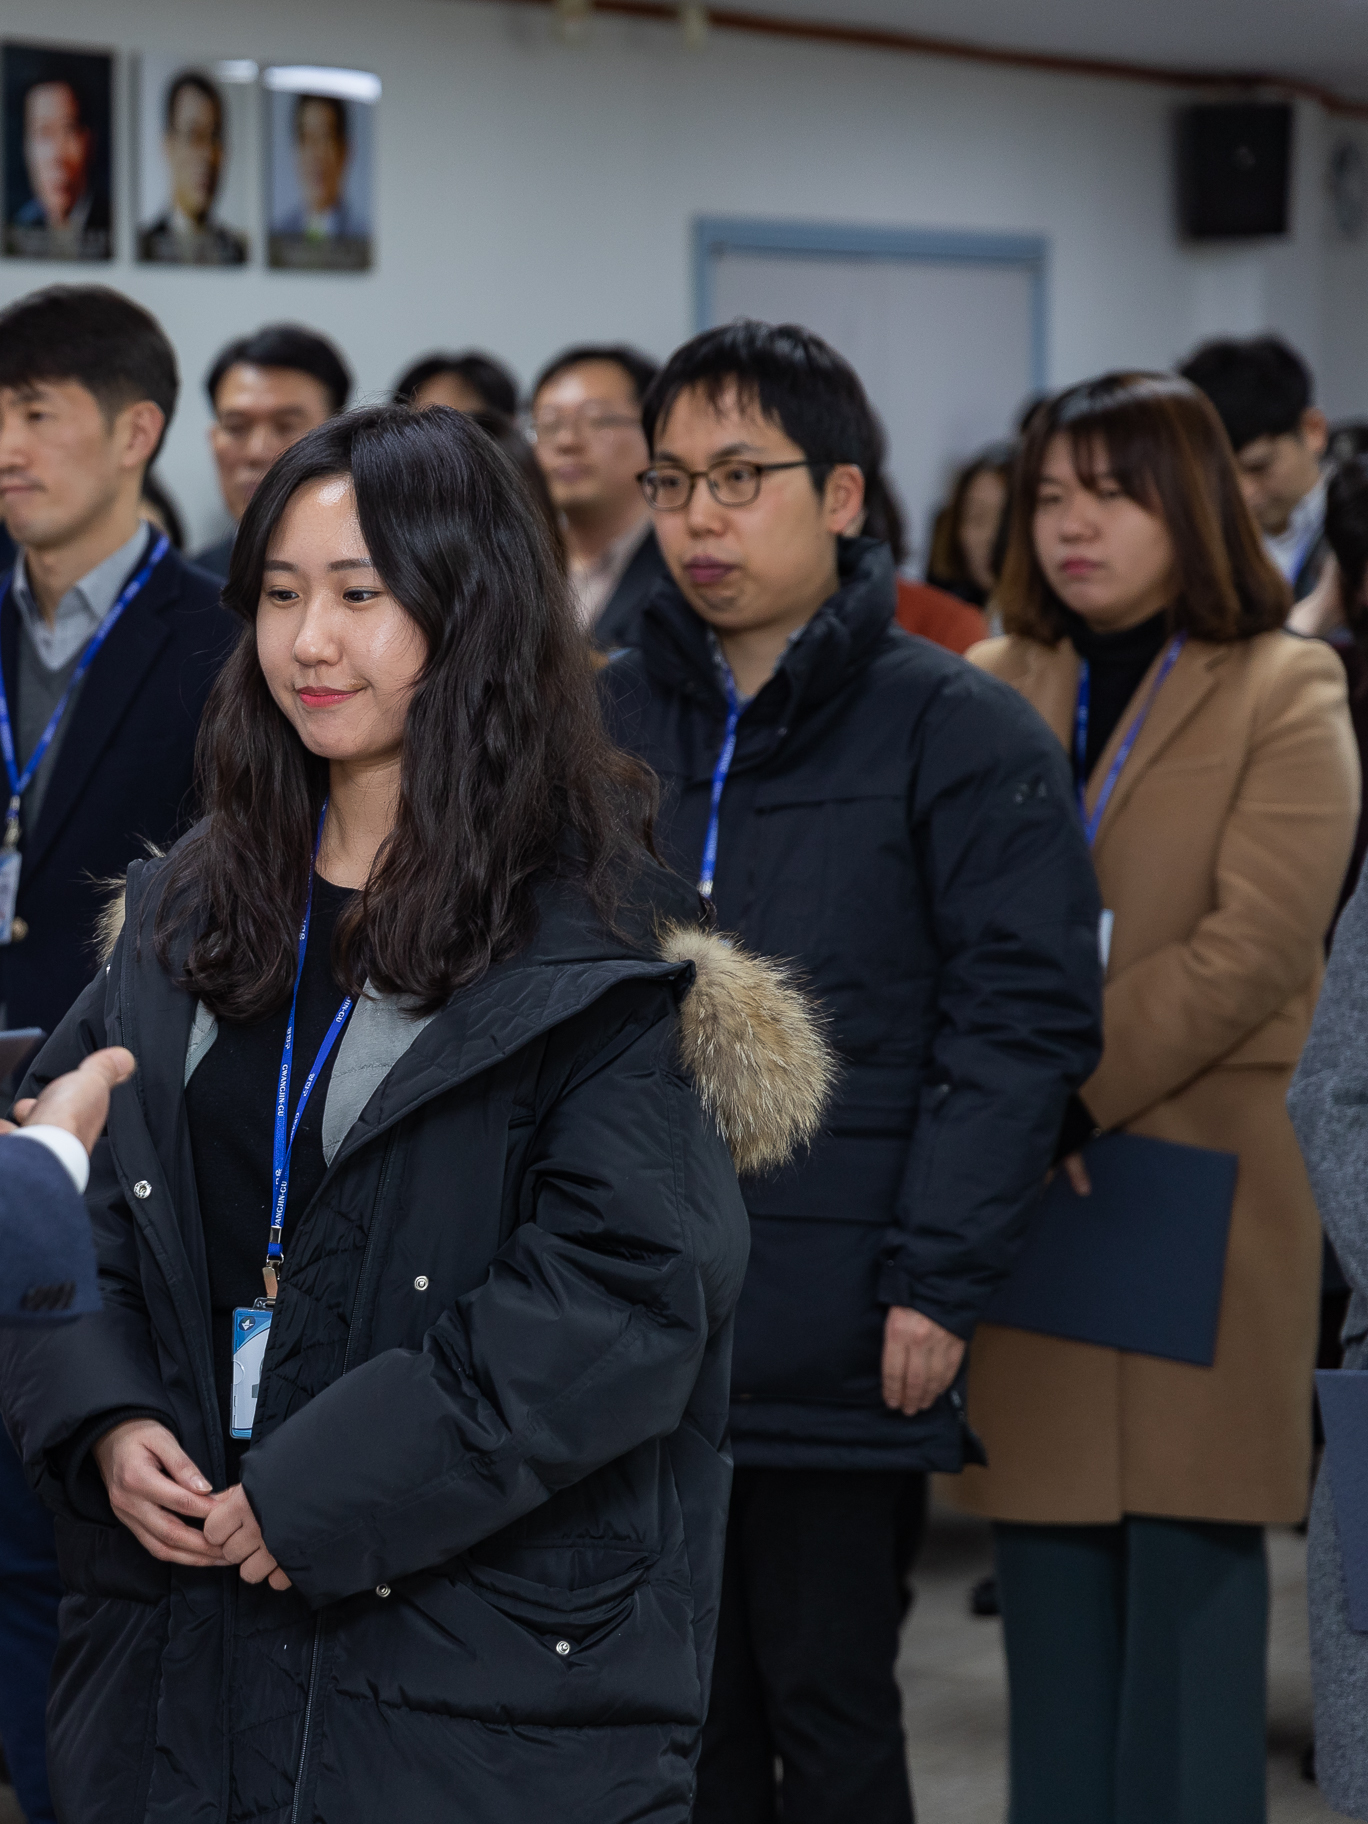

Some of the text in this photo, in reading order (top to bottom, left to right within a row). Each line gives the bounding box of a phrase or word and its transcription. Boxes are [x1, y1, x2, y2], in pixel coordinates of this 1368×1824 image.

[335, 998, 351, 1023] JIN-GU
[277, 1064, 289, 1117] GWANGJIN-GU
[275, 1181, 288, 1227] ANGJIN-GU
